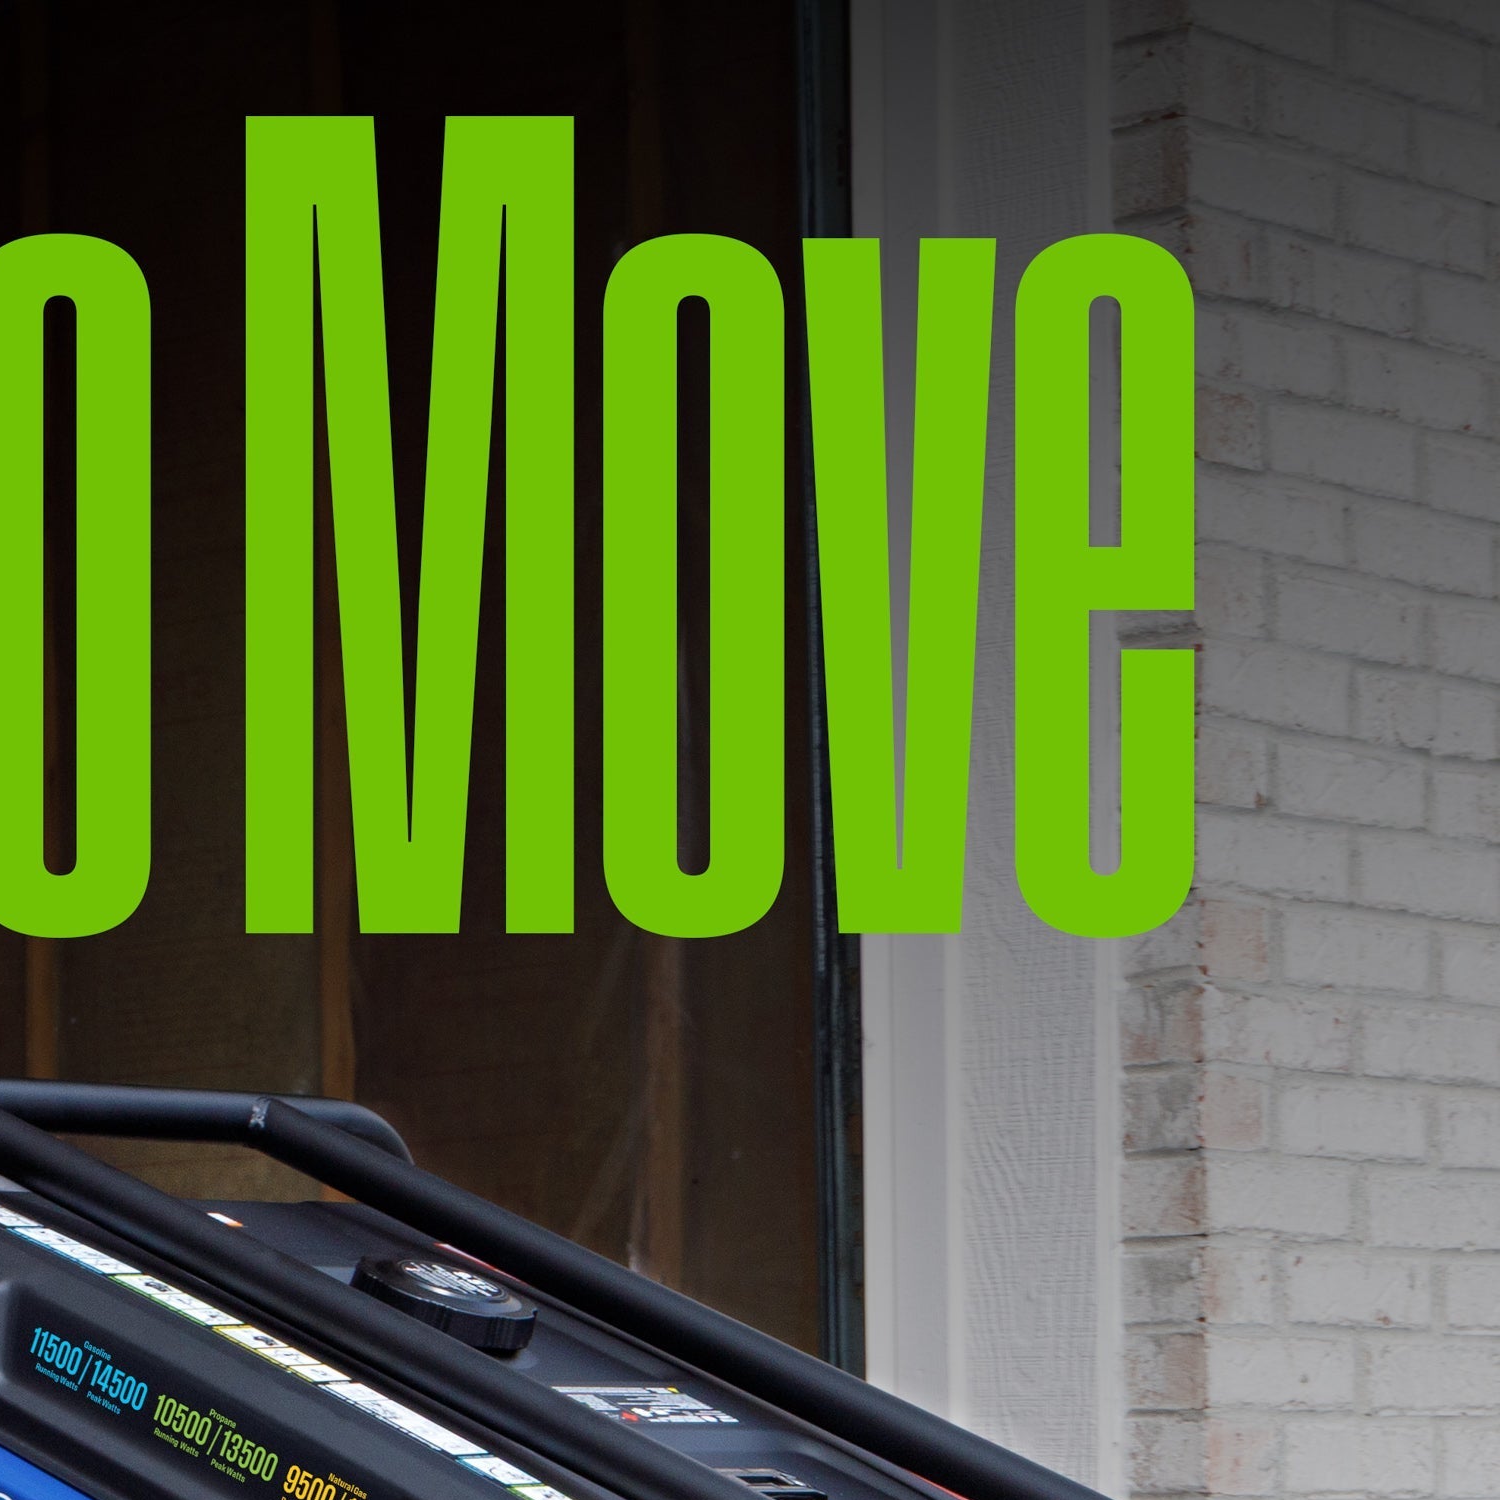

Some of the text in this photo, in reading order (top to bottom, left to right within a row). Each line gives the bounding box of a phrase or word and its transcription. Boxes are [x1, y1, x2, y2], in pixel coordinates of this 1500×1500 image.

[83, 1341, 112, 1361] Gasoline
[30, 1327, 148, 1411] 11500 14500
[35, 1363, 78, 1391] Running Watts
[87, 1390, 121, 1415] Peak Watts
[209, 1408, 236, 1429] Propane
[154, 1394, 278, 1481] 10500 13500
[154, 1427, 200, 1457] Running Watts
[210, 1458, 246, 1483] Peak Watts
[328, 1473, 367, 1499] Natural Gas
